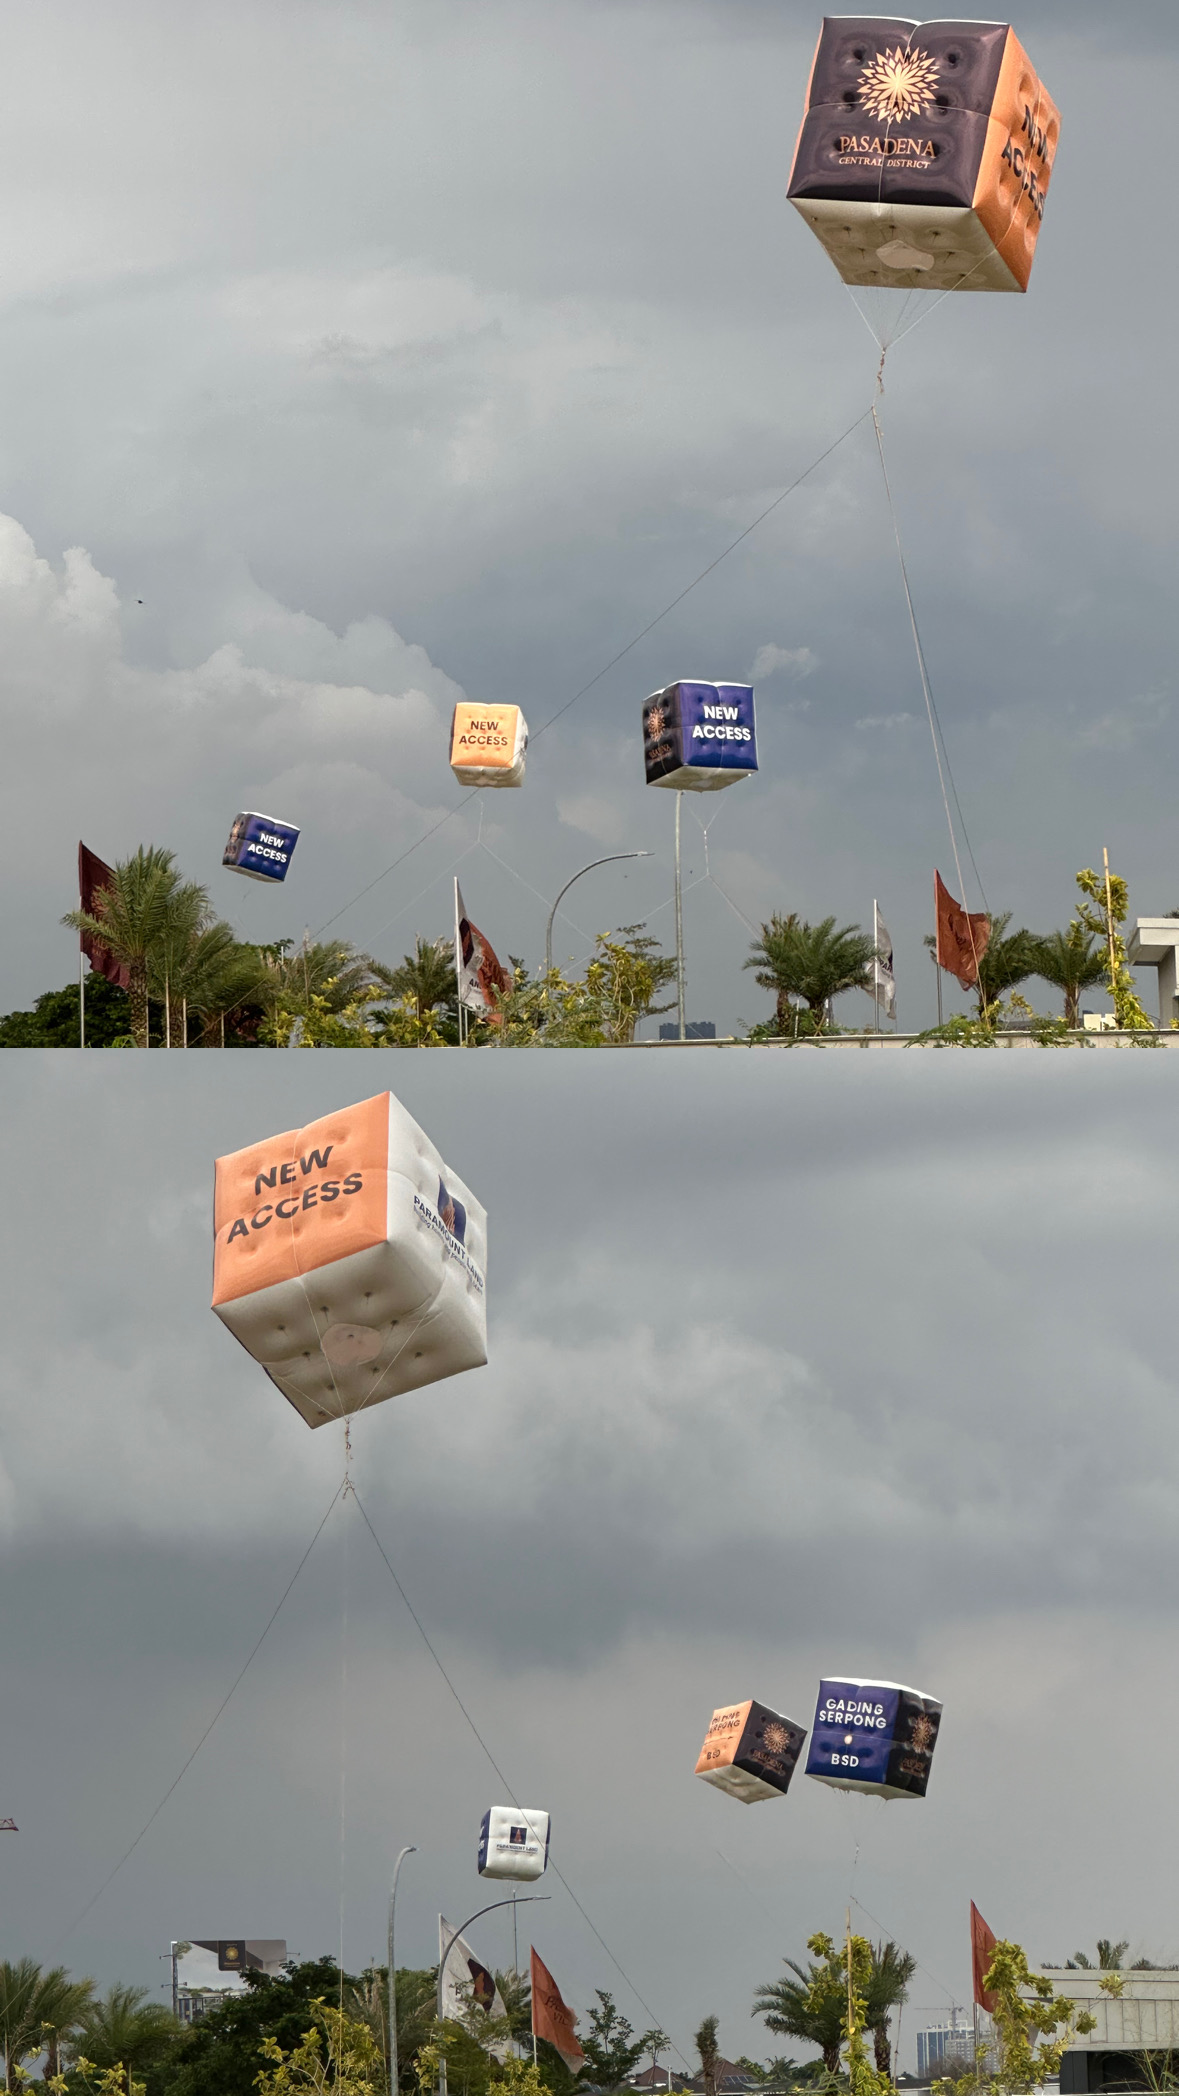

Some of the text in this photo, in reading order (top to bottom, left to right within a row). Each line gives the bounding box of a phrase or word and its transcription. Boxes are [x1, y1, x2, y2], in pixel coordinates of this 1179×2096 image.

[840, 136, 936, 159] PASADENA
[839, 157, 931, 169] CENTRAL DISTRICT
[704, 705, 739, 720] NEW
[470, 721, 499, 731] NEW
[692, 725, 751, 741] ACCESS
[459, 735, 508, 746] ACCESS
[260, 833, 284, 848] NEW
[247, 843, 287, 863] ACCESS
[254, 1145, 334, 1196] NEW
[227, 1172, 363, 1244] ACCESS
[414, 1195, 465, 1259] PARAMOUNT
[467, 1258, 483, 1287] LAND
[826, 1699, 884, 1715] GADING
[819, 1710, 887, 1729] SERPONG
[831, 1753, 859, 1767] BSD
